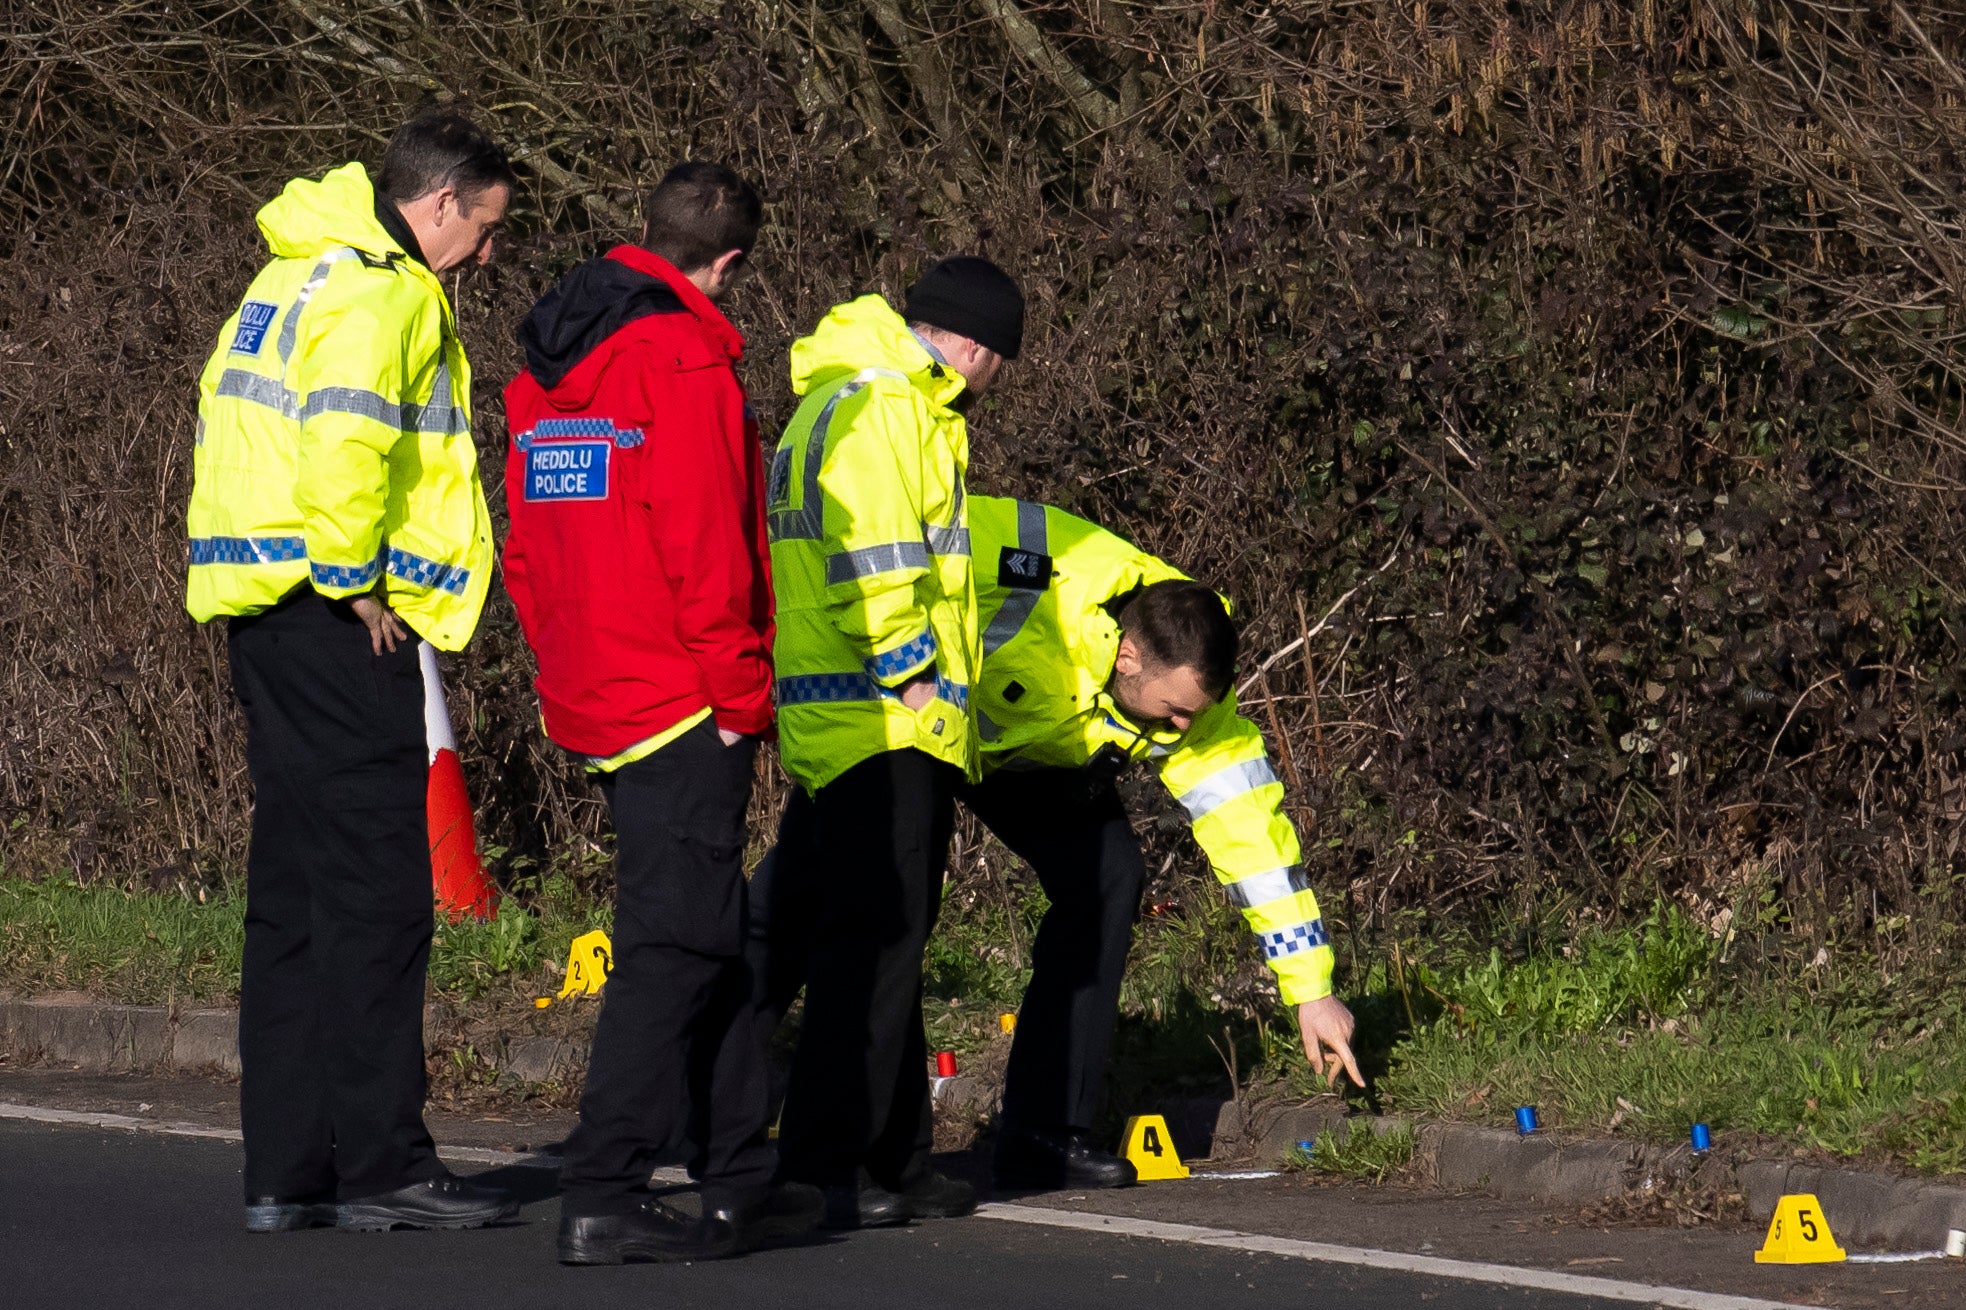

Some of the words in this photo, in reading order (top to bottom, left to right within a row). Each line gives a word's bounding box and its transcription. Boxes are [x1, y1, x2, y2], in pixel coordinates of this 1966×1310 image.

[533, 450, 592, 470] HEDDLU
[535, 473, 587, 494] POLICE
[574, 960, 581, 981] 2
[1143, 1126, 1163, 1157] 4
[1775, 1219, 1782, 1240] 5
[1798, 1210, 1818, 1242] 5
